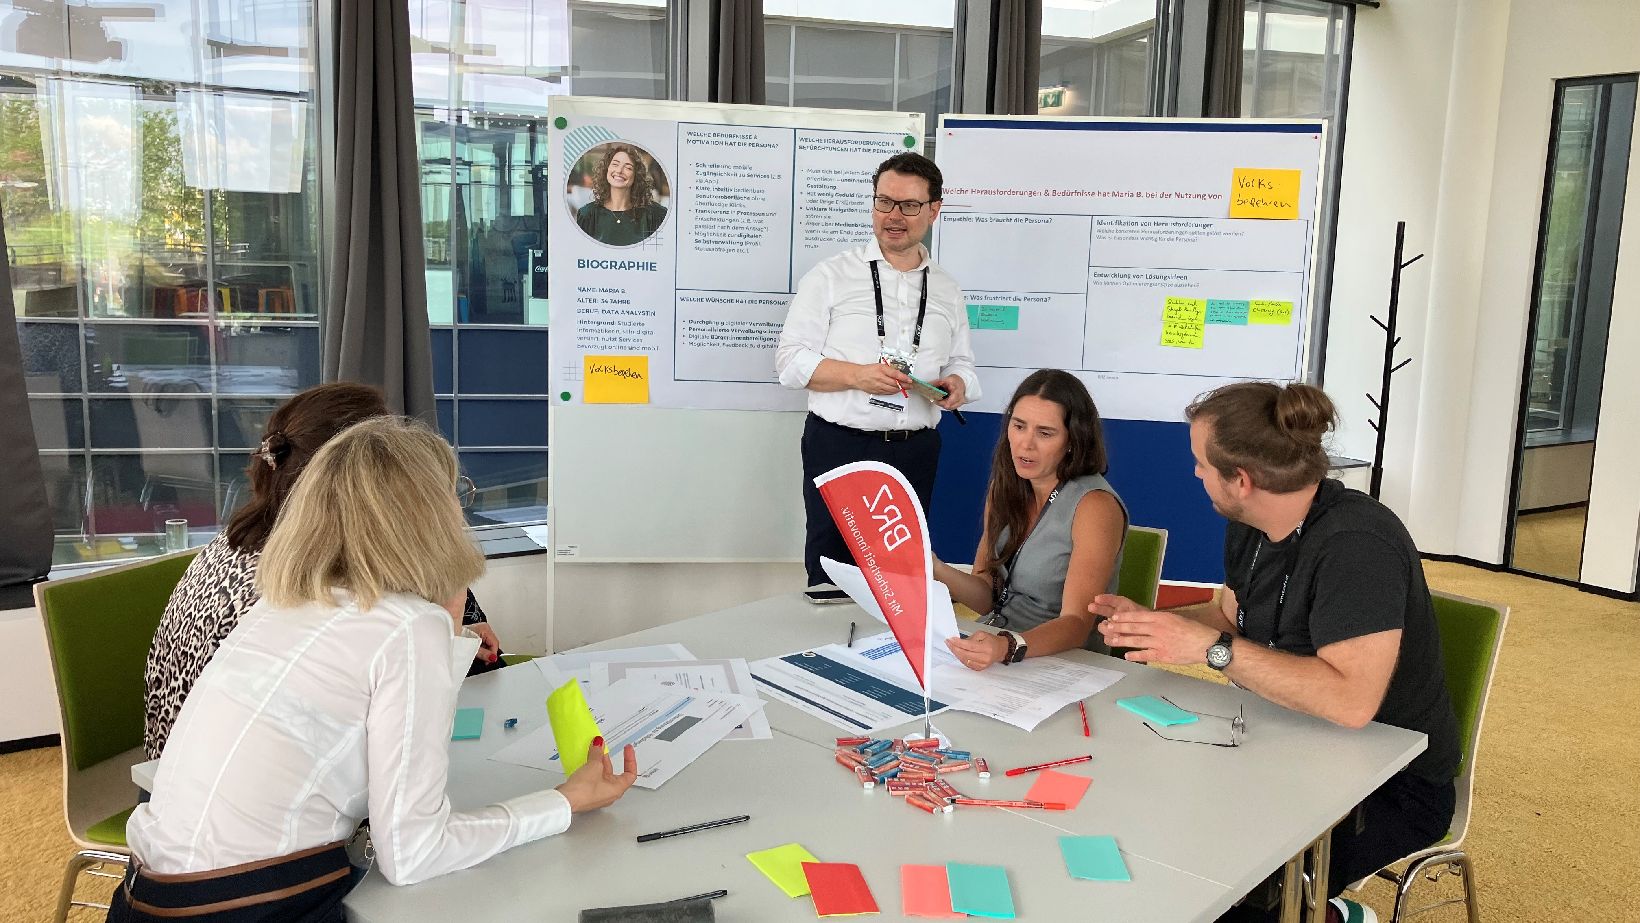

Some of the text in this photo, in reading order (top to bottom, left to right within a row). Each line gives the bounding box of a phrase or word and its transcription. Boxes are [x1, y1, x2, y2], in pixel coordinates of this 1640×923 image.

[970, 188, 1042, 198] Herausforderungen
[1052, 190, 1094, 198] Bedürfnisse
[1159, 191, 1172, 199] der
[1174, 192, 1206, 200] Nutzung
[577, 258, 658, 272] BIOGRAPHIE
